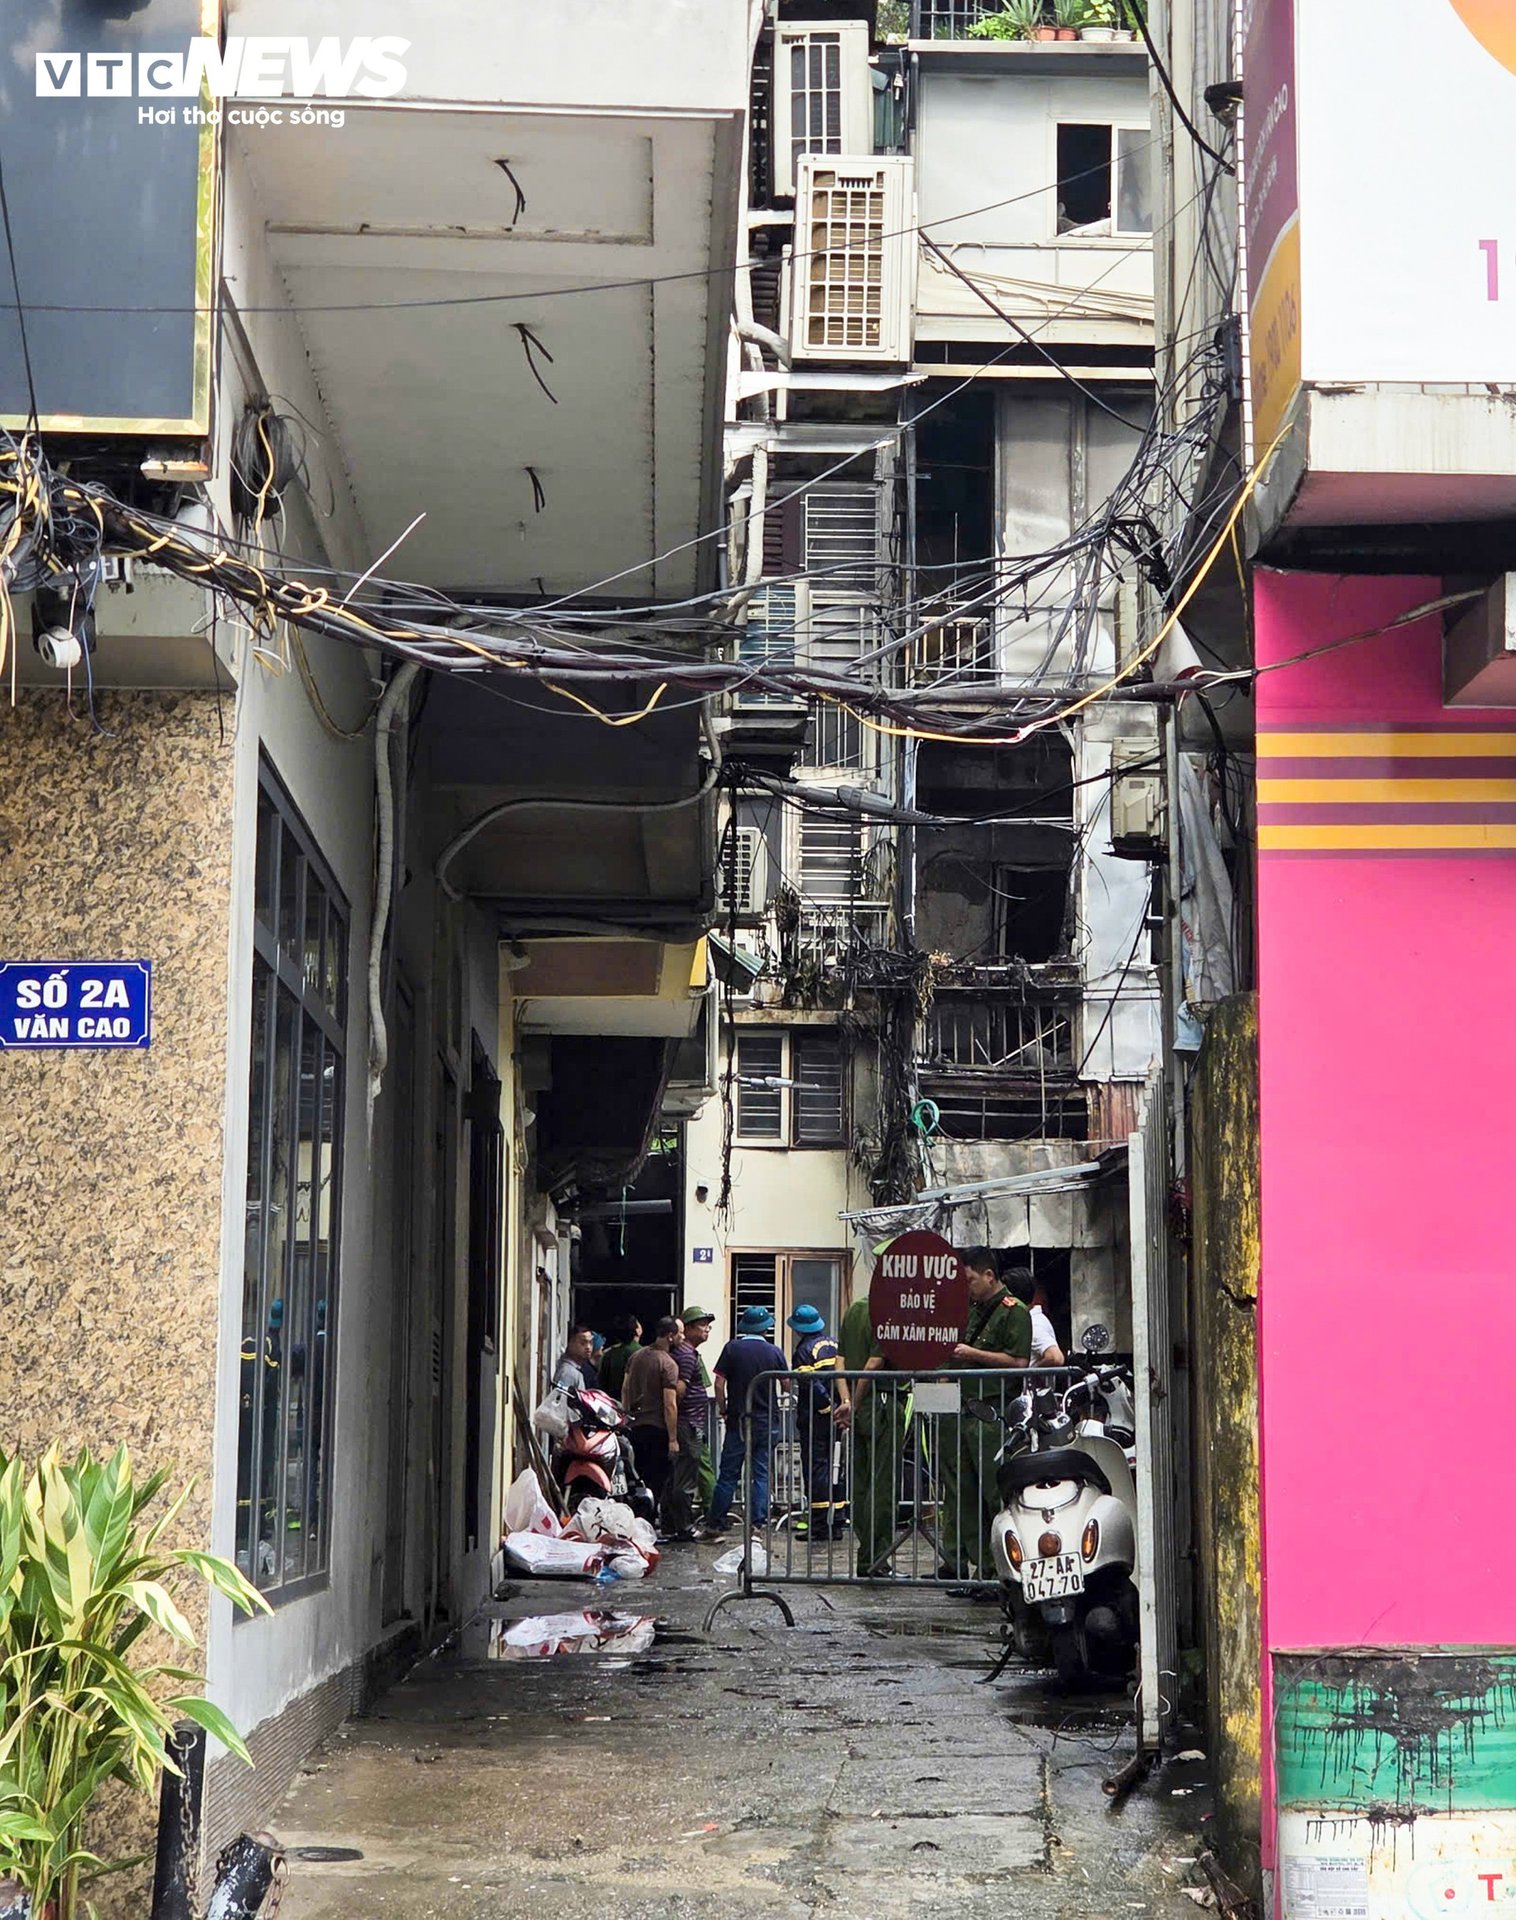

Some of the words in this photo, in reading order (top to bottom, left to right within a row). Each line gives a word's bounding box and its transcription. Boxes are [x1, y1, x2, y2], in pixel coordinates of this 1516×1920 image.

[16, 969, 70, 1009] SỐ
[79, 979, 130, 1009] 2A
[14, 1013, 69, 1039] VĂN
[77, 1017, 131, 1038] CAO
[882, 1255, 918, 1278] KHU
[923, 1253, 958, 1285] VỰC
[900, 1288, 920, 1309] BẢO
[923, 1289, 936, 1314] VỆ
[876, 1318, 900, 1340] CẤM
[902, 1322, 926, 1341] XÂM
[928, 1327, 959, 1346] PHẠM
